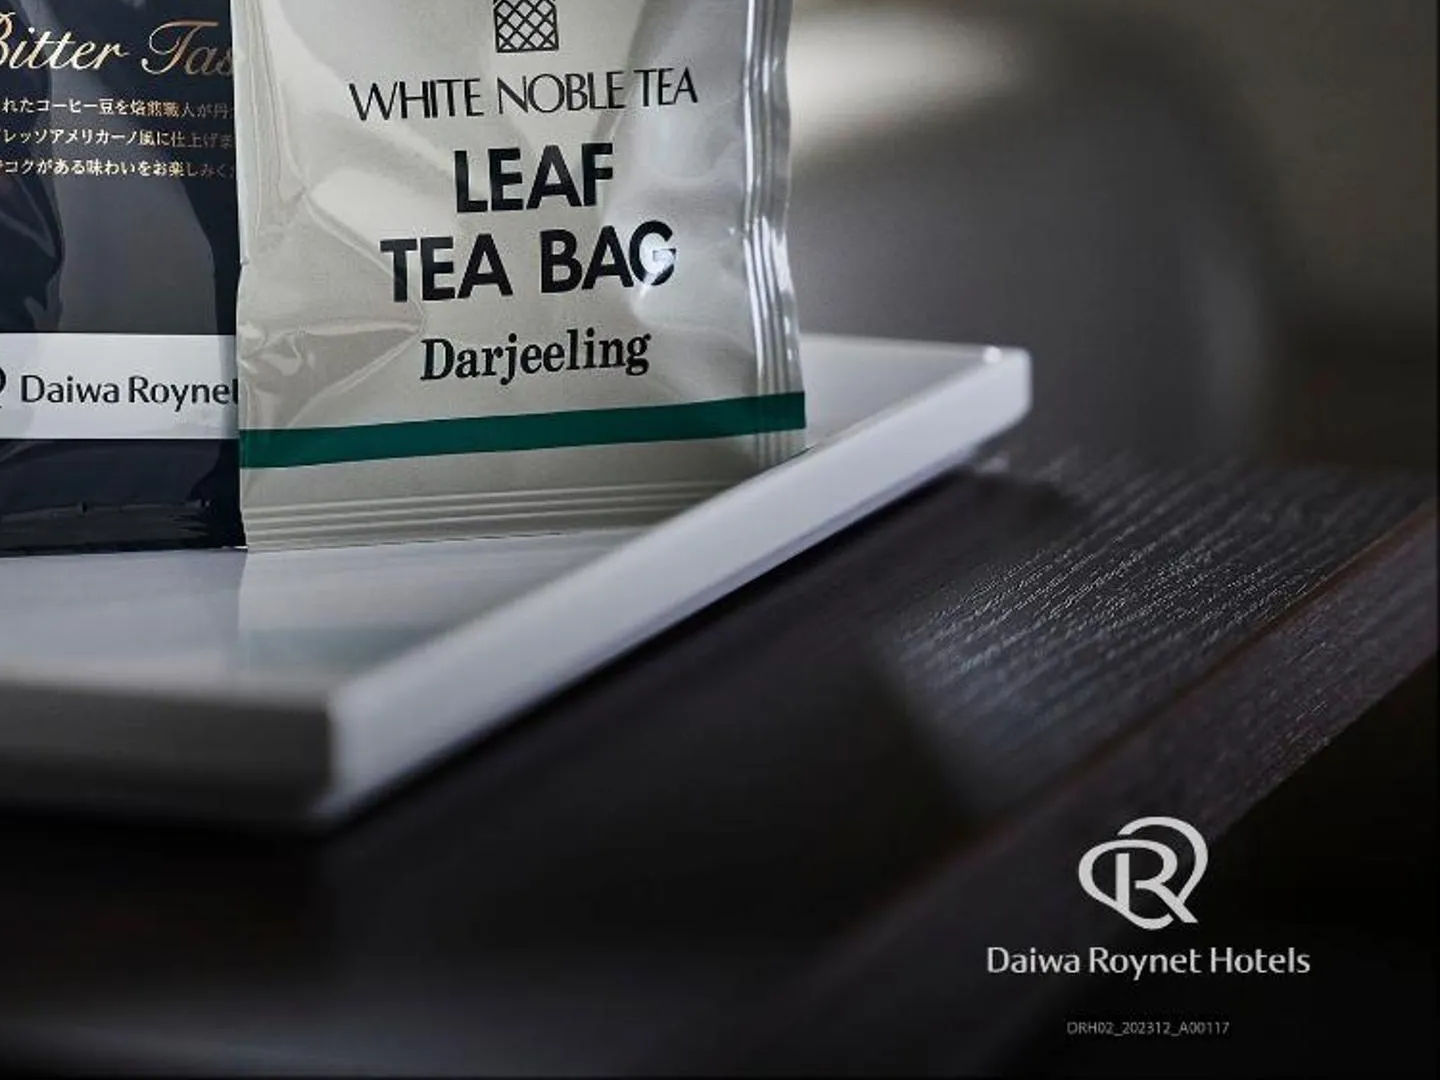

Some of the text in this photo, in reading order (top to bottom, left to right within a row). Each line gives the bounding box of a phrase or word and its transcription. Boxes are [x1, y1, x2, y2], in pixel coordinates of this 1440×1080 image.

[348, 66, 699, 121] WHITE NOBLE TEA
[454, 142, 614, 214] LEAF
[379, 219, 677, 303] TEA BAG
[419, 327, 652, 386] Darjeeling
[21, 374, 120, 404] Daiwa
